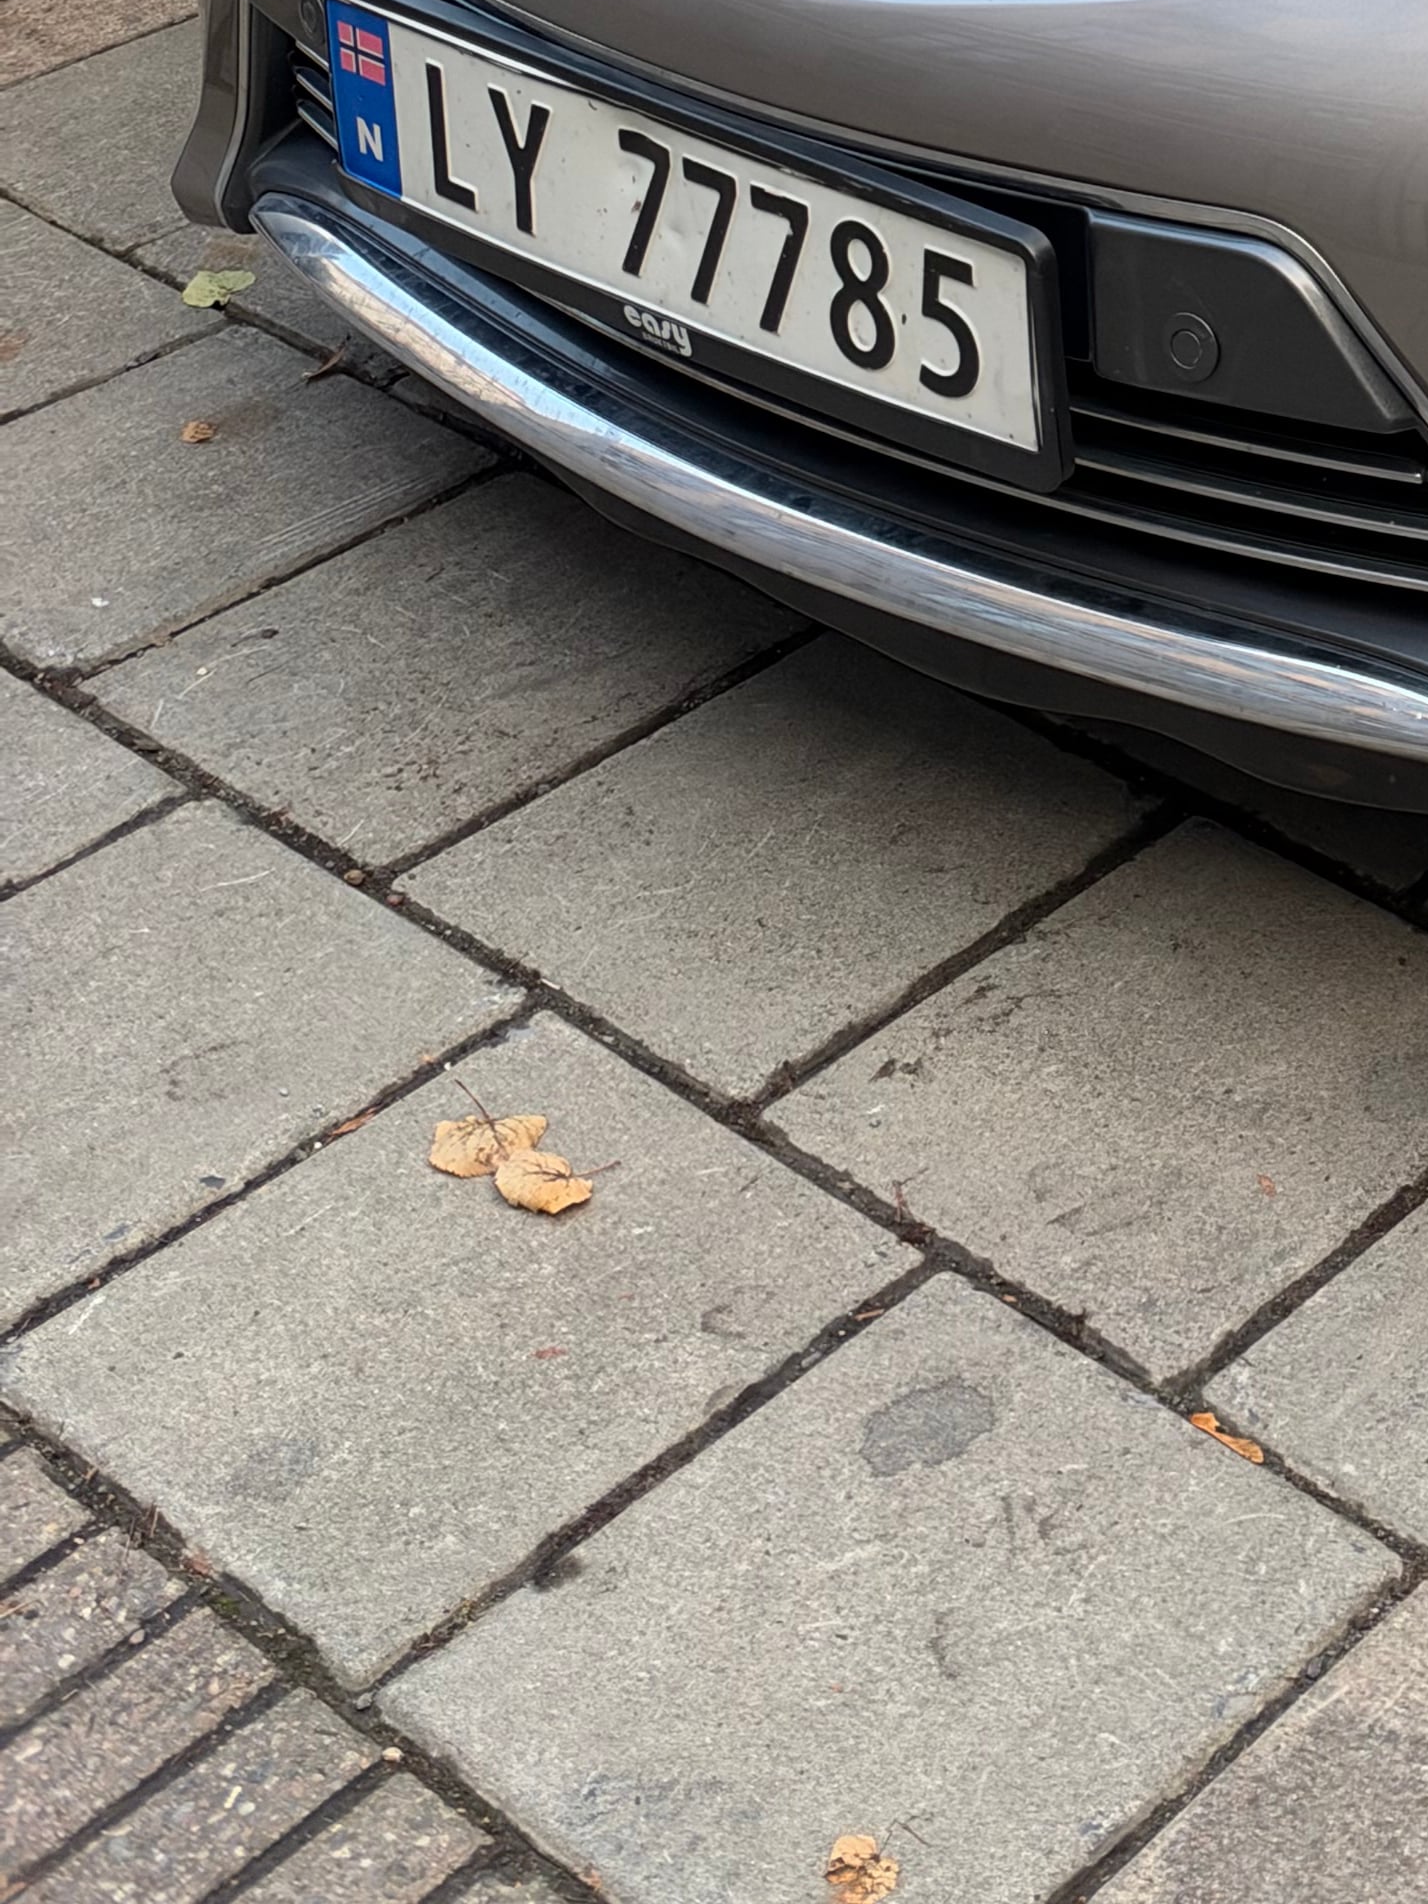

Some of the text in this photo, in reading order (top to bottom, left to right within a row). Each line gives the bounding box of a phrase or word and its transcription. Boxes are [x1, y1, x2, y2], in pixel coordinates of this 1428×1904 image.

[356, 116, 384, 163] N
[424, 59, 981, 398] LY 77785
[623, 304, 693, 358] easy
